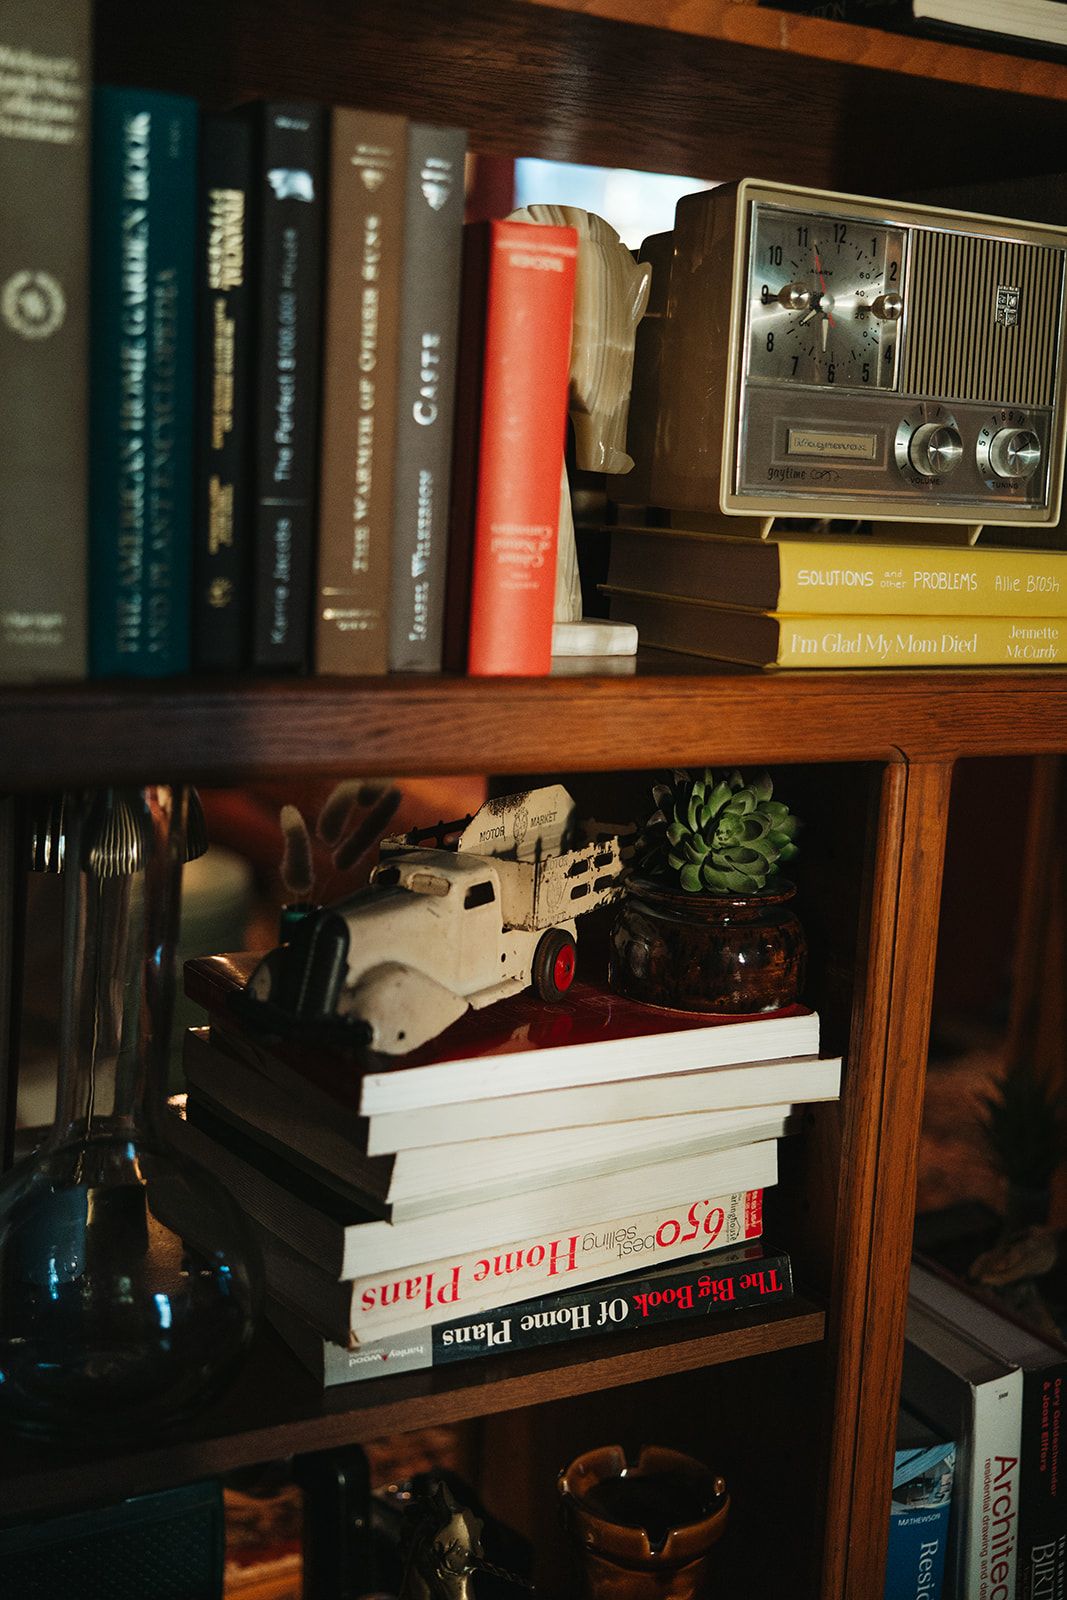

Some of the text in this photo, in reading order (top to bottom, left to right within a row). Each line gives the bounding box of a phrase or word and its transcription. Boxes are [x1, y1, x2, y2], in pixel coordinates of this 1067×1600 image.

[797, 227, 809, 247] 11
[833, 223, 847, 244] 12
[769, 245, 783, 266] 10
[871, 237, 877, 257] 1
[859, 272, 871, 280] 60
[890, 261, 897, 281] 2
[761, 284, 769, 305] 9
[766, 332, 774, 352] 8
[884, 344, 892, 364] 4
[791, 356, 799, 376] 7
[827, 364, 835, 383] 6
[862, 363, 870, 383] 5
[767, 467, 807, 481] gaytime
[910, 477, 941, 485] VOLUME
[992, 481, 1019, 489] TUNING
[797, 569, 978, 591] SOLUTIONS and other PROBLEMS
[995, 575, 1061, 593] Allie Brosh
[1008, 625, 1059, 640] Jennette
[791, 632, 978, 660] I'm Glad My Mom Died
[1006, 644, 1059, 661] McCurdy
[479, 812, 558, 843] MOTOR MARKET
[656, 1200, 725, 1250] 650
[582, 1225, 637, 1252] selling
[617, 1234, 656, 1259] best
[473, 1234, 581, 1282] Home
[361, 1263, 462, 1313] Plans
[442, 1267, 783, 1347] The Big Book Of Home Plans
[981, 1457, 992, 1512] residential
[979, 1515, 991, 1557] drawing
[980, 1560, 990, 1580] and
